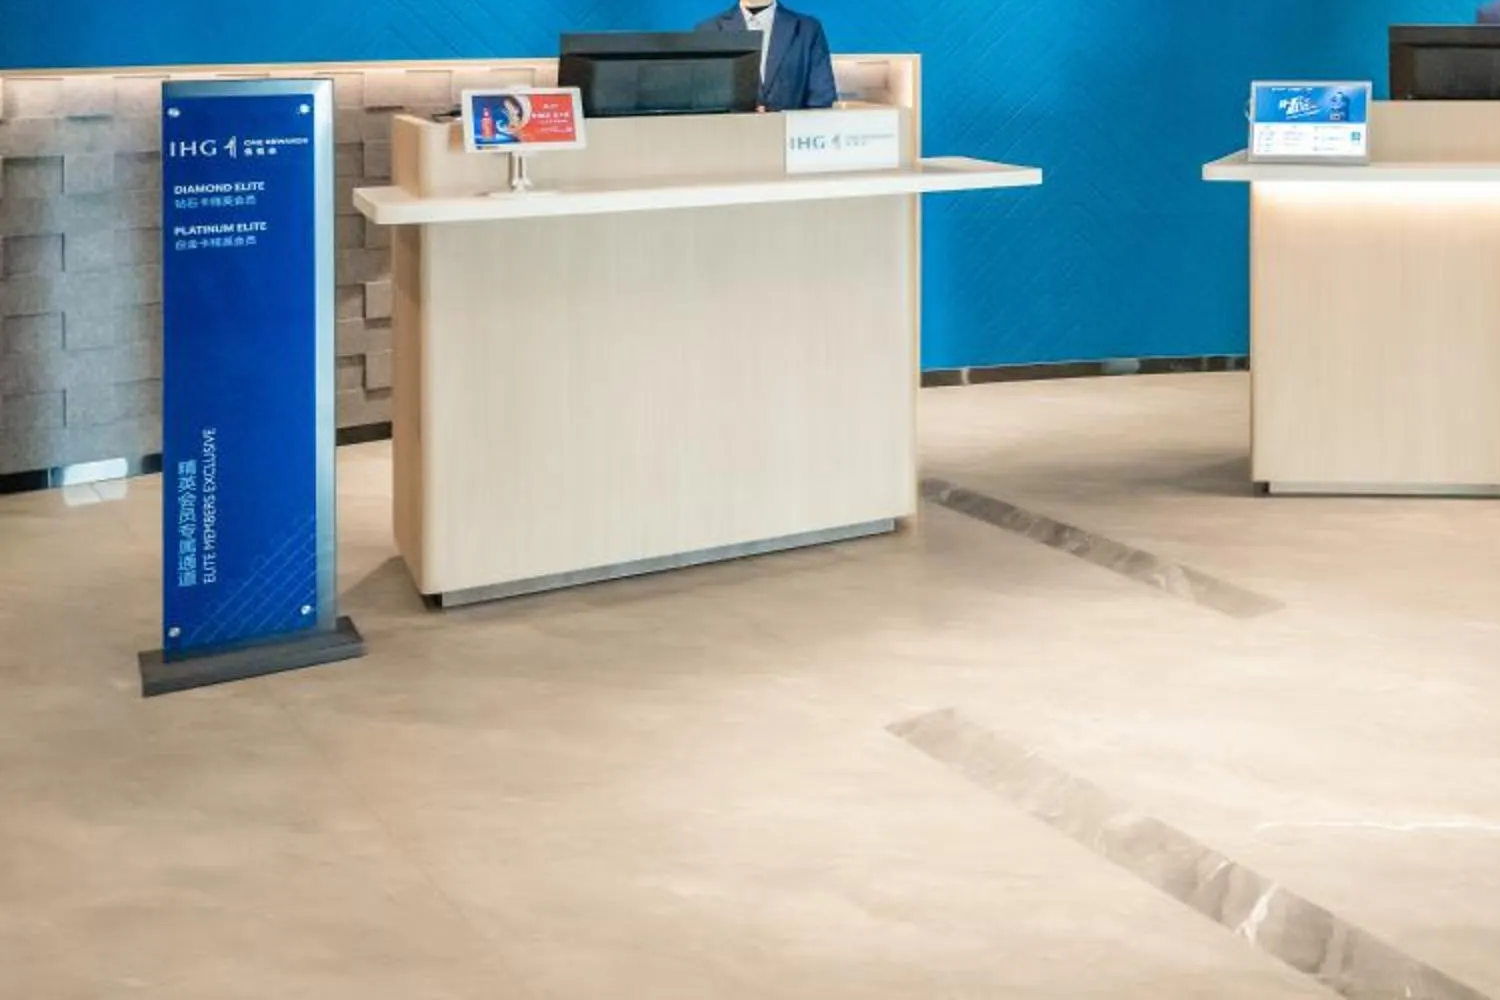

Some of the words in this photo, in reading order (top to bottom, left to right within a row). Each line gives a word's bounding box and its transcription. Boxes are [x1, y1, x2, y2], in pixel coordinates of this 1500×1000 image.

[169, 139, 217, 158] IHG
[790, 135, 826, 151] IHG
[174, 183, 233, 195] DIAMOND
[234, 181, 265, 192] ELITE
[174, 224, 235, 236] PLATINUM
[236, 221, 267, 233] ELITE
[202, 427, 217, 493] EXCLUSIVE
[203, 495, 217, 551] MEMBERS
[203, 552, 217, 584] ELITE
